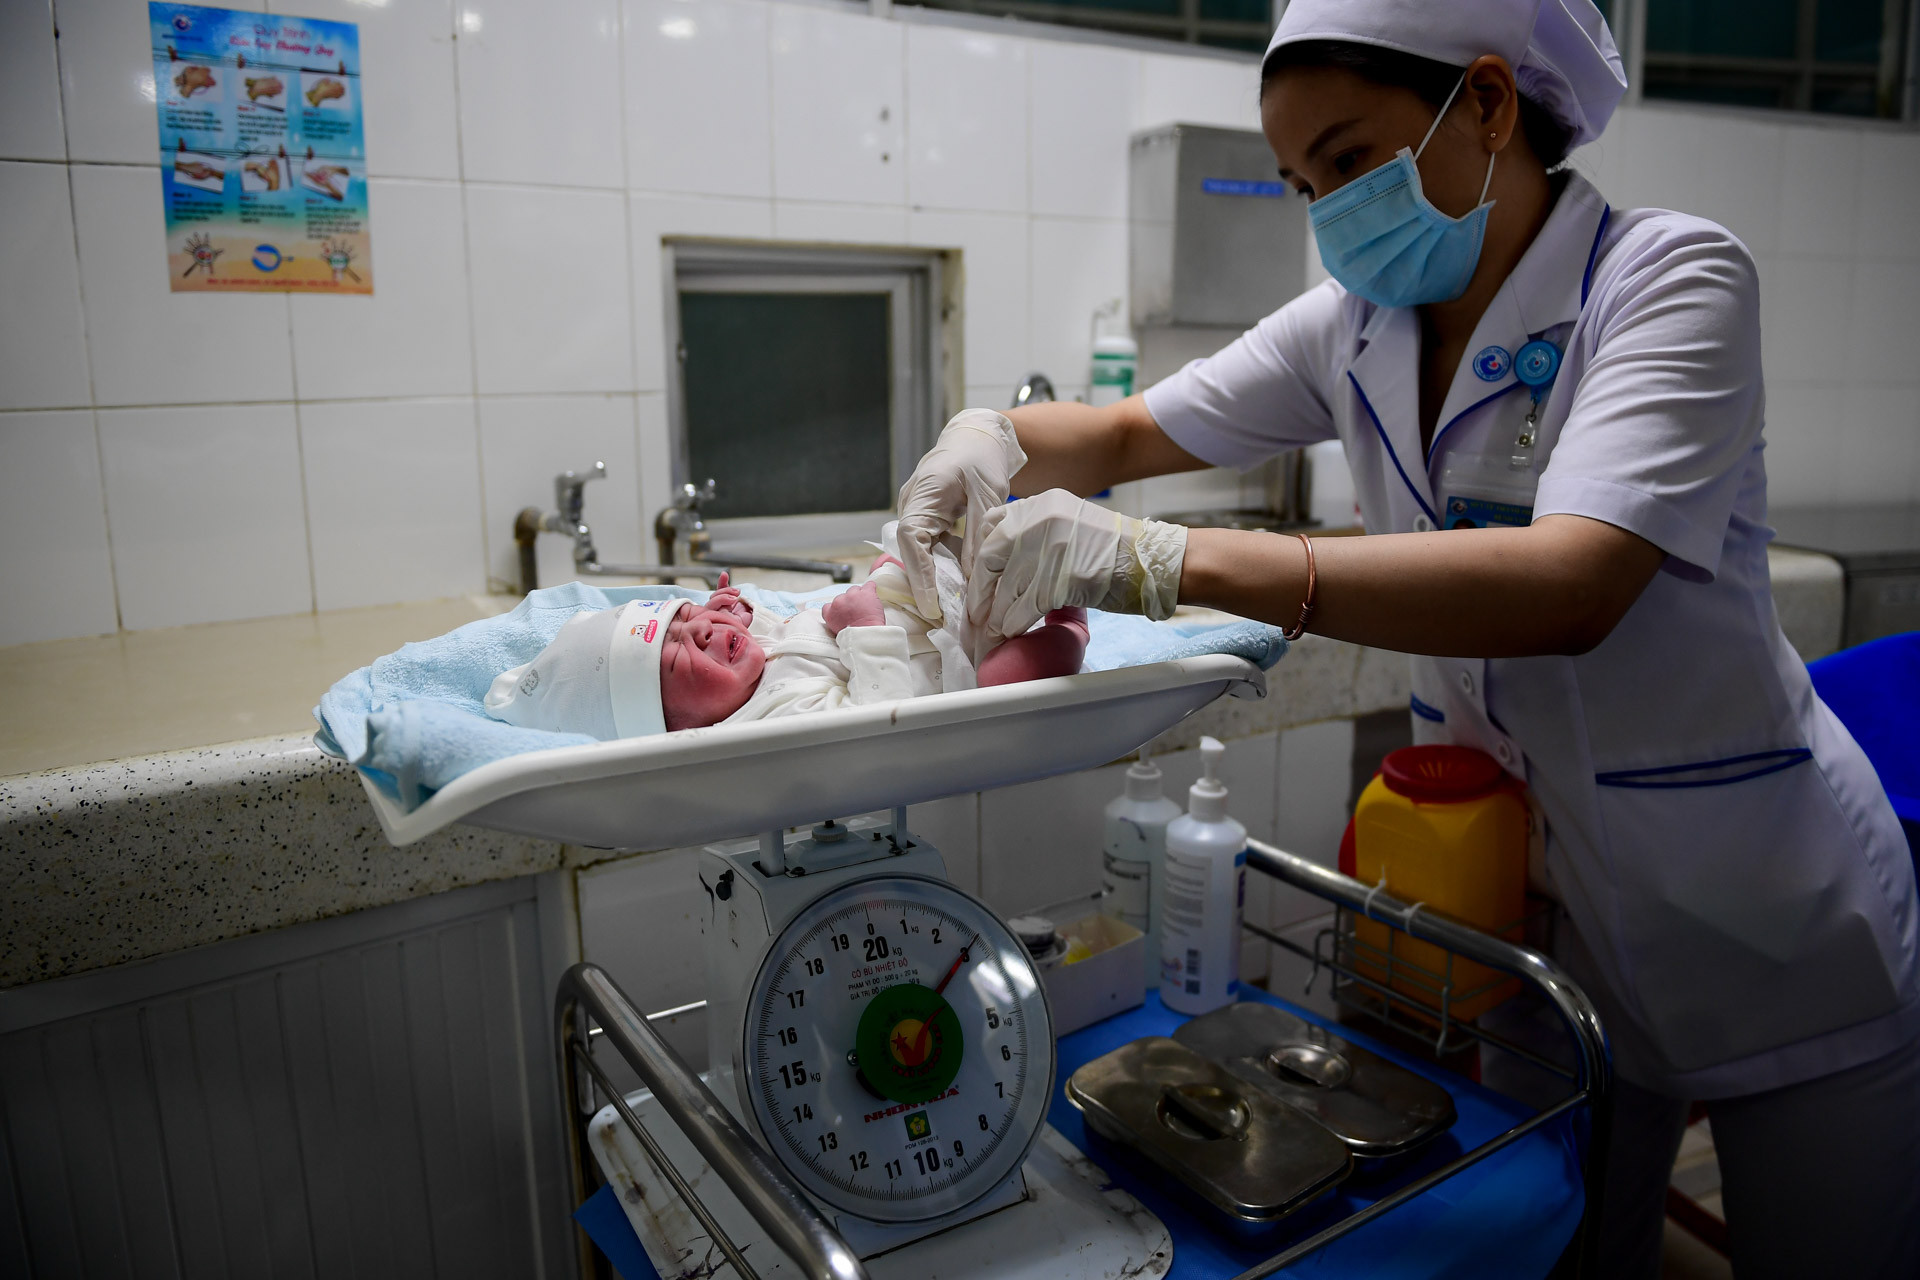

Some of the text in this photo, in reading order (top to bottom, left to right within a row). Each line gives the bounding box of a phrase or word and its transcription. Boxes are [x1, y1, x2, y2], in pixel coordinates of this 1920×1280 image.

[867, 923, 875, 935] 0
[900, 919, 919, 934] 1 kg
[931, 928, 942, 944] 2
[831, 934, 850, 952] 19
[863, 936, 903, 962] 20 kg
[805, 958, 824, 977] 18
[787, 989, 805, 1009] 17
[985, 1007, 1012, 1029] 5 kg
[778, 1027, 798, 1046] 16
[1001, 1045, 1011, 1061] 6
[779, 1061, 821, 1089] 15 kg
[994, 1081, 1004, 1098] 7
[793, 1104, 813, 1123] 14
[978, 1114, 989, 1131] 8
[818, 1132, 838, 1152] 13
[953, 1140, 964, 1157] 9
[849, 1151, 869, 1172] 12
[884, 1159, 902, 1179] 11
[913, 1147, 954, 1176] 10 kg
